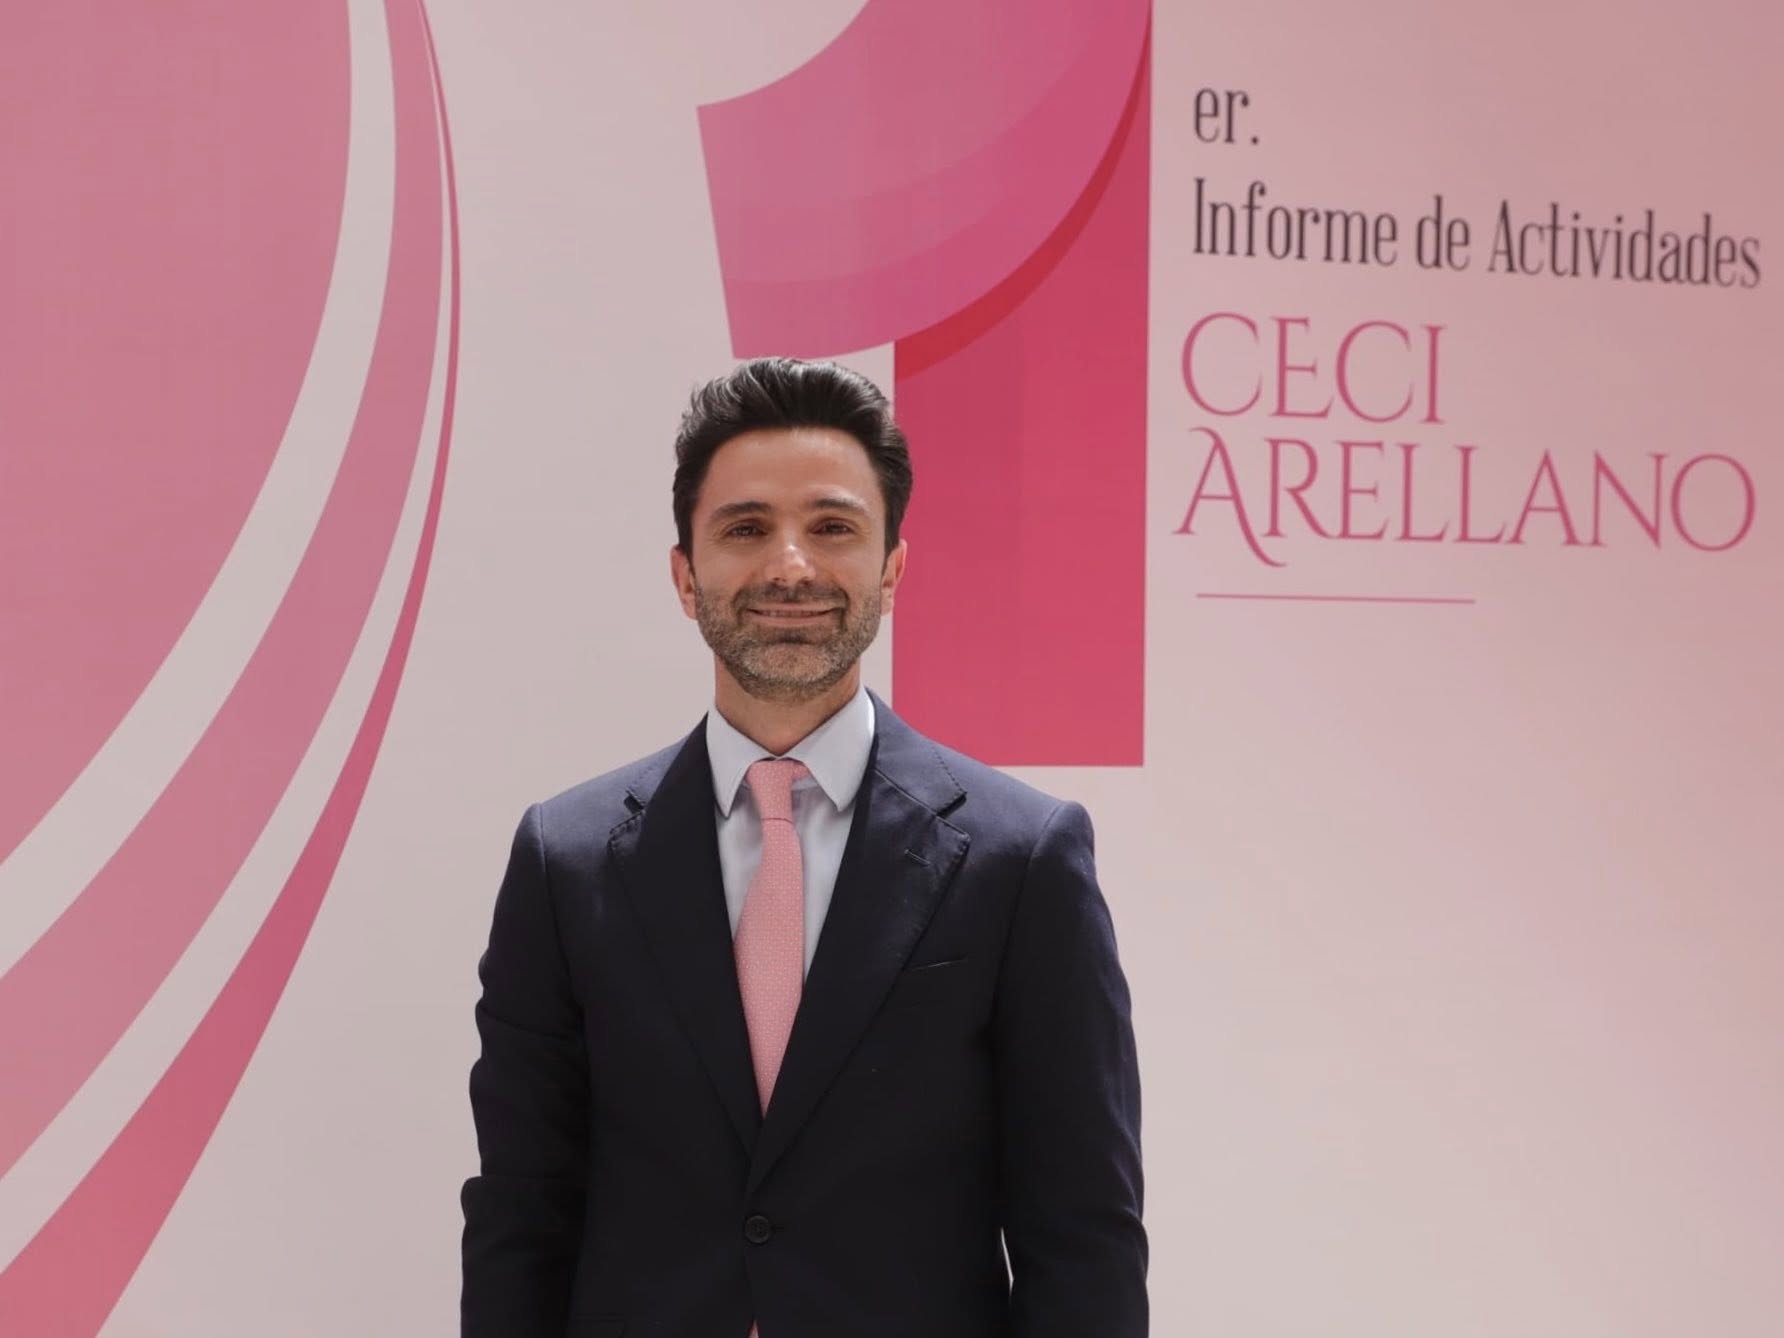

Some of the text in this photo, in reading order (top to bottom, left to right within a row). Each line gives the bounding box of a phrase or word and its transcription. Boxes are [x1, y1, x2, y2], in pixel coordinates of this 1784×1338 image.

[1193, 87, 1260, 146] er.
[1192, 177, 1762, 288] Informe de Actividades
[1181, 312, 1447, 424] CECI
[1172, 426, 1756, 568] ARELLANO
